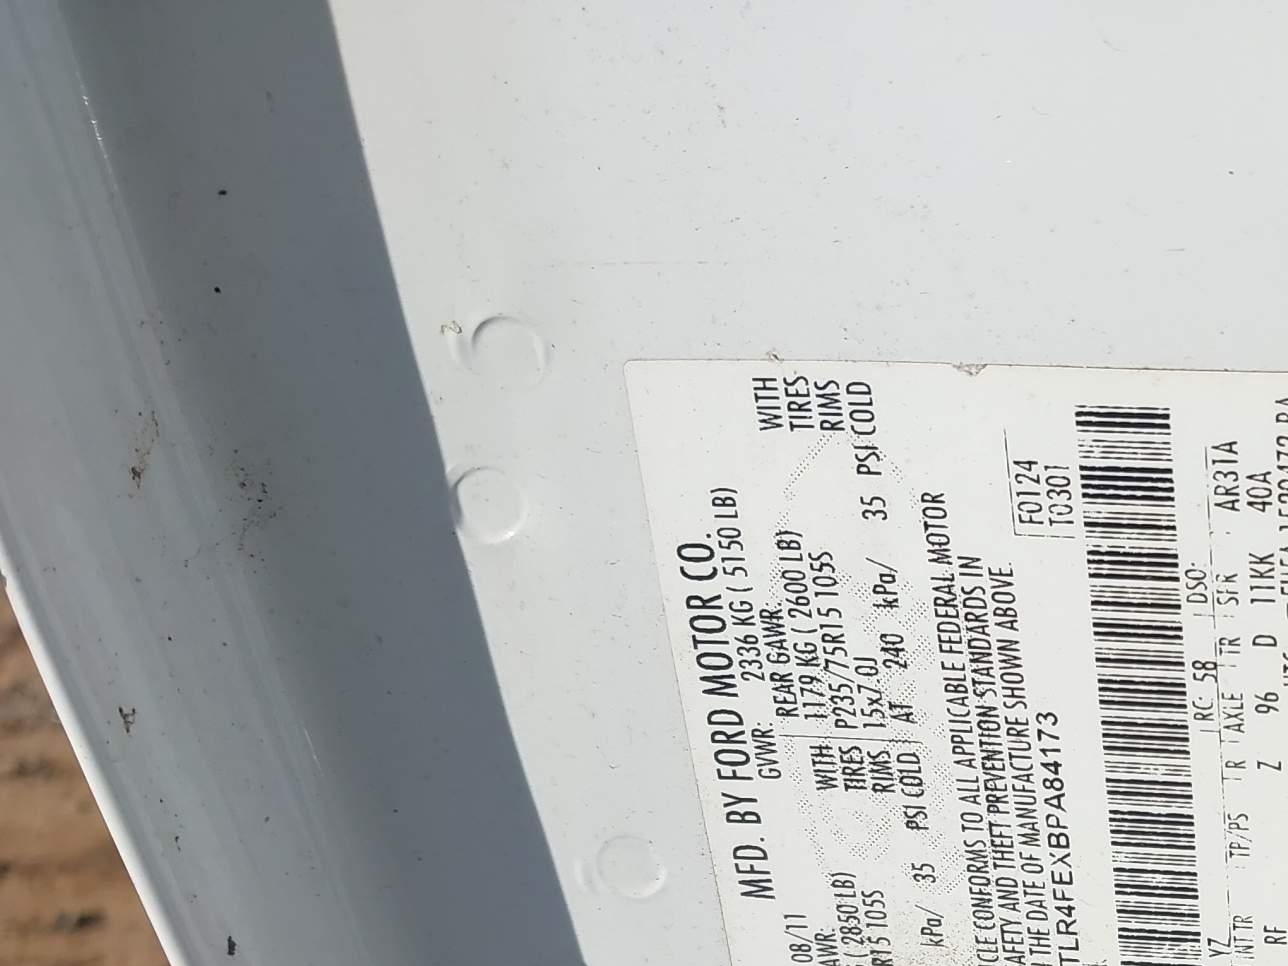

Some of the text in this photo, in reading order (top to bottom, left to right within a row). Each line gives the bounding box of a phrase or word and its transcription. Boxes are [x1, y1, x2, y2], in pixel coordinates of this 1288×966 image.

[751, 376, 785, 431] WITH
[813, 379, 845, 431] RIMS
[844, 380, 877, 435] COLD
[853, 444, 882, 475] PSI
[1211, 439, 1241, 512] AR31A
[708, 486, 742, 518] LB)
[859, 495, 888, 520] 35
[1012, 459, 1044, 525] F0124
[1246, 469, 1272, 513] 40A
[774, 529, 806, 562] LB)
[920, 491, 953, 565] MOTOR
[781, 374, 861, 729] P235/75R15 105S TIRES
[956, 555, 983, 577] IN
[986, 561, 1019, 631] ABOVE.
[1248, 552, 1276, 604] 11KK
[727, 599, 756, 626] KG
[929, 572, 964, 654] FEDERAL
[733, 633, 765, 681] 2336
[756, 600, 800, 717] REAR GAWR:
[792, 640, 821, 667] KG
[878, 632, 908, 668] 240
[960, 585, 998, 698] STANDARDS
[1218, 636, 1242, 656] TR
[1251, 634, 1277, 646] D
[995, 638, 1027, 709] SHOWN
[1191, 659, 1218, 683] 58
[673, 531, 775, 899] MFD. BY FORD MOTOR CO.
[797, 673, 828, 720] 1179
[887, 701, 915, 723] AT
[940, 660, 977, 769] APPLICABLE
[1220, 691, 1245, 733] AXLE
[1255, 690, 1279, 714] 96
[748, 721, 782, 779] GVWR:
[808, 743, 839, 791] WITH
[838, 744, 867, 792] TIRES
[866, 749, 896, 793] RIMS
[974, 705, 1010, 814] PREVENTION
[1224, 758, 1246, 769] R
[1256, 759, 1281, 770] Z
[895, 751, 925, 798] COLD
[954, 774, 982, 805] ALL
[1004, 715, 1040, 847] MANUFACTURE
[902, 804, 930, 830] PSI
[959, 811, 985, 833] TO
[1225, 811, 1253, 858] TP/PS
[987, 819, 1016, 871] THEFT
[1018, 851, 1044, 874] OF
[828, 870, 859, 898] LB)
[910, 862, 936, 883] 35
[962, 838, 996, 930] CONFORMS
[993, 876, 1021, 912] AND
[860, 888, 889, 929] 105S
[1021, 879, 1049, 921] DATE
[781, 912, 816, 963] 08/11
[1026, 926, 1052, 957] THE
[1207, 937, 1231, 958] YZ
[1232, 914, 1255, 959] INT TR
[1263, 924, 1287, 945] RF
